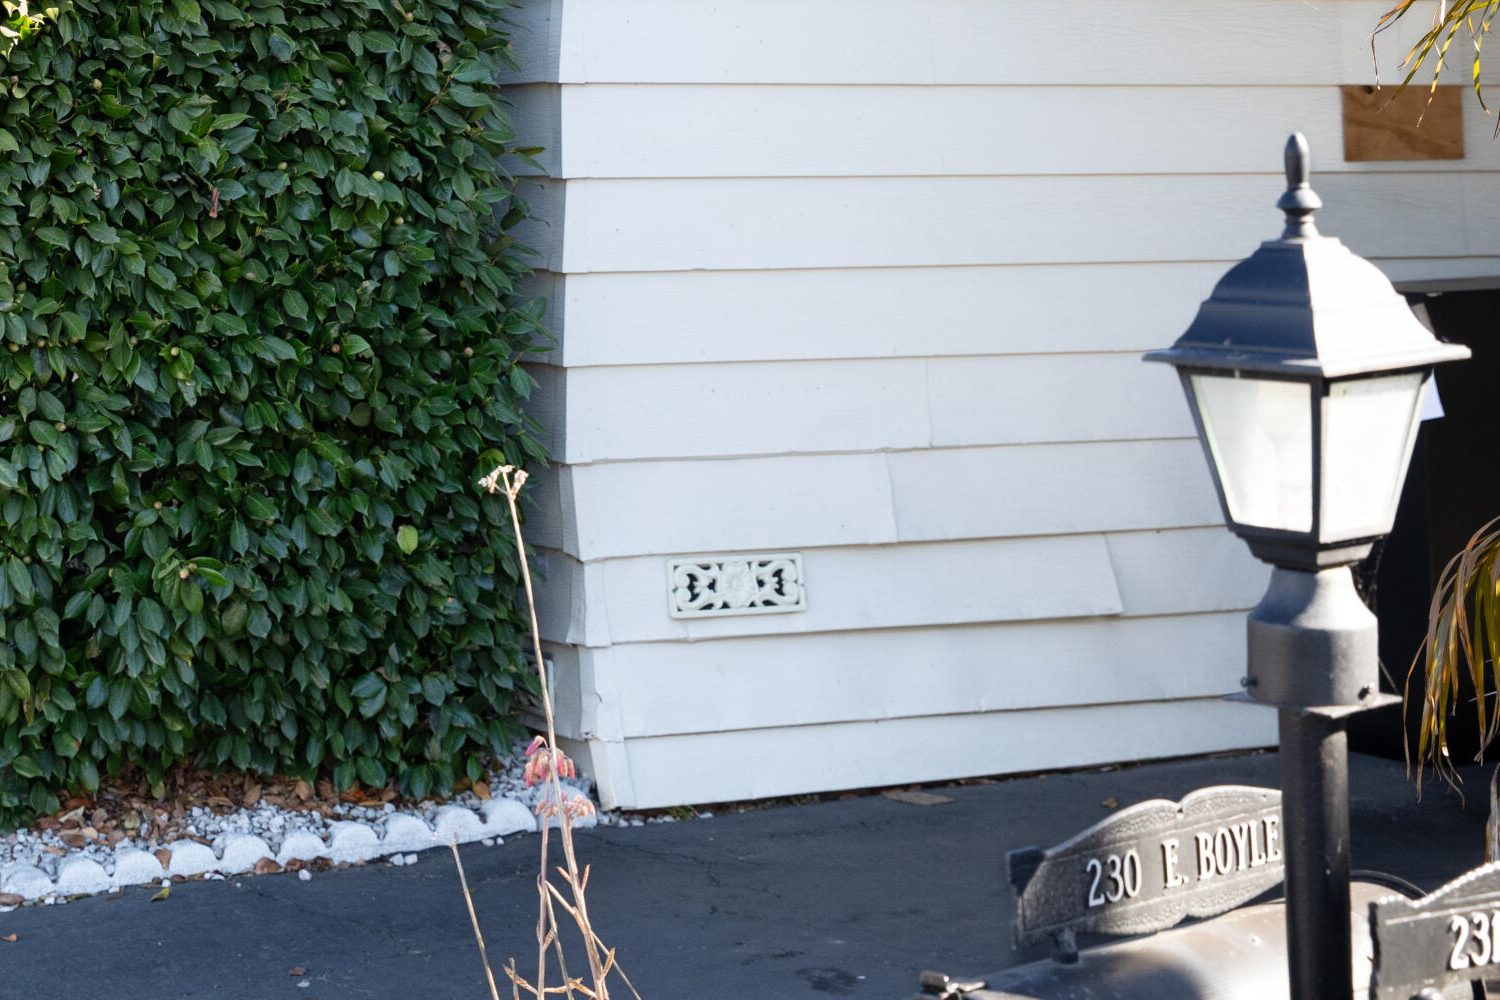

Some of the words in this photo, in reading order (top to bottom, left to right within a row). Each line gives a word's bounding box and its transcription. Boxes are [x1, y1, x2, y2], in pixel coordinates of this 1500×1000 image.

[1086, 849, 1142, 908] 230
[1161, 838, 1189, 889] E.
[1196, 815, 1281, 881] BOYLE
